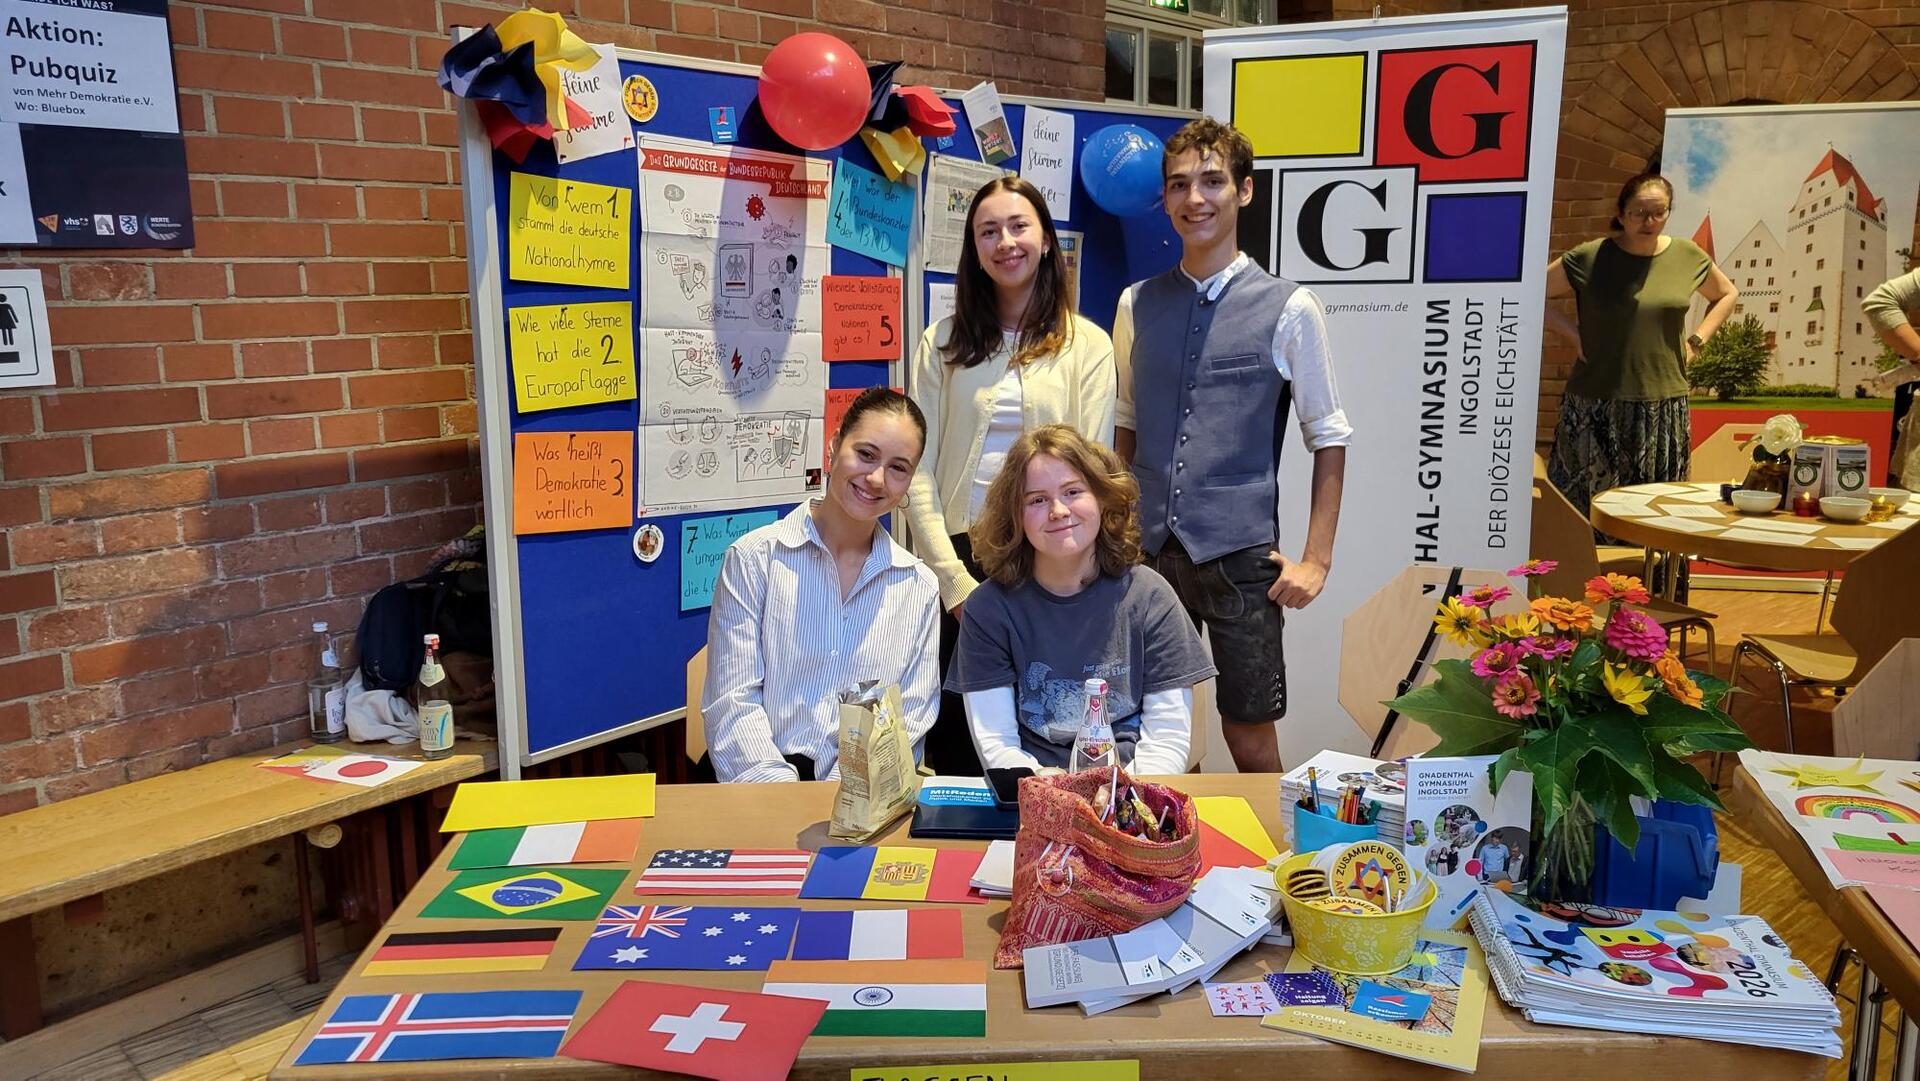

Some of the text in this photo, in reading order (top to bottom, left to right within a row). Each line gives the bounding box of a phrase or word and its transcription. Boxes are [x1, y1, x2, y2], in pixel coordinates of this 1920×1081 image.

[81, 0, 114, 11] WAS?
[6, 17, 103, 46] Aktion:
[11, 55, 117, 85] Pubquiz
[13, 88, 154, 106] von Mehr Demokratie e.V.
[15, 102, 86, 115] Wo: Bluebox
[1403, 61, 1516, 160] G
[1034, 119, 1060, 142] deine
[663, 154, 718, 173] GRUNDGESETZ
[729, 162, 787, 180] BUNDESREPUBLIK
[1028, 147, 1063, 171] Stimme
[529, 183, 604, 215] Von wem
[775, 181, 822, 196] DEUTSCHLAND
[884, 186, 901, 203] der
[518, 212, 619, 240] stammt die deutsche
[859, 223, 892, 253] BRD
[1297, 178, 1403, 272] G
[525, 244, 616, 273] Nationalhymne
[516, 311, 622, 333] Wie viele Sterne
[536, 338, 592, 363] hat die
[1459, 298, 1484, 435] INGOLSTADT
[525, 369, 627, 399] Europaflagge
[1488, 297, 1520, 548] DER DIÖZESE EICHSTÄTT
[533, 439, 602, 461] Was heißt
[536, 465, 607, 493] Demokratie
[535, 498, 594, 520] wörtlich
[703, 524, 723, 541] Was
[684, 577, 699, 597] die
[1335, 845, 1412, 884] ZUSAMMEN GEGEN
[1725, 961, 1778, 998] 2026
[1293, 1010, 1347, 1026] OKTOBER
